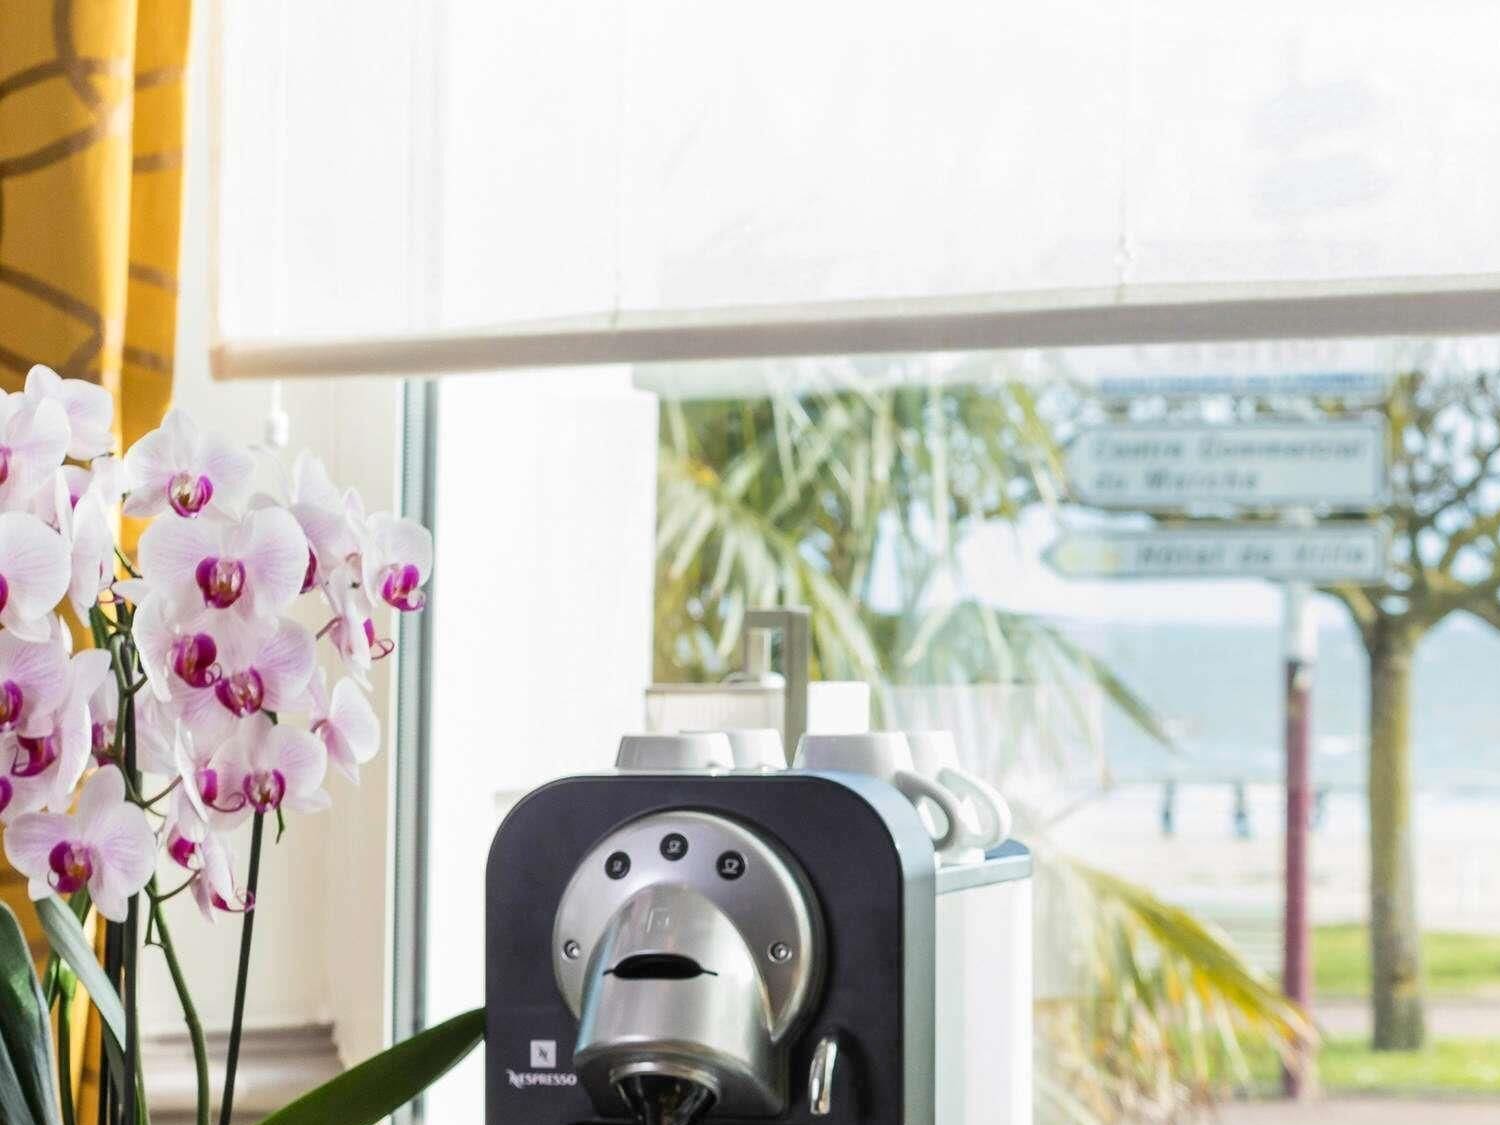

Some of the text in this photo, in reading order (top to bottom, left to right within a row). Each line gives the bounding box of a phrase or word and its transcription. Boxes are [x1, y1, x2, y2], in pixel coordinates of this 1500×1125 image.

[1095, 437, 1364, 459] Centre Commercial
[1240, 544, 1272, 565] de
[1296, 543, 1365, 566] Ville
[505, 1068, 578, 1089] NESPRESSO
